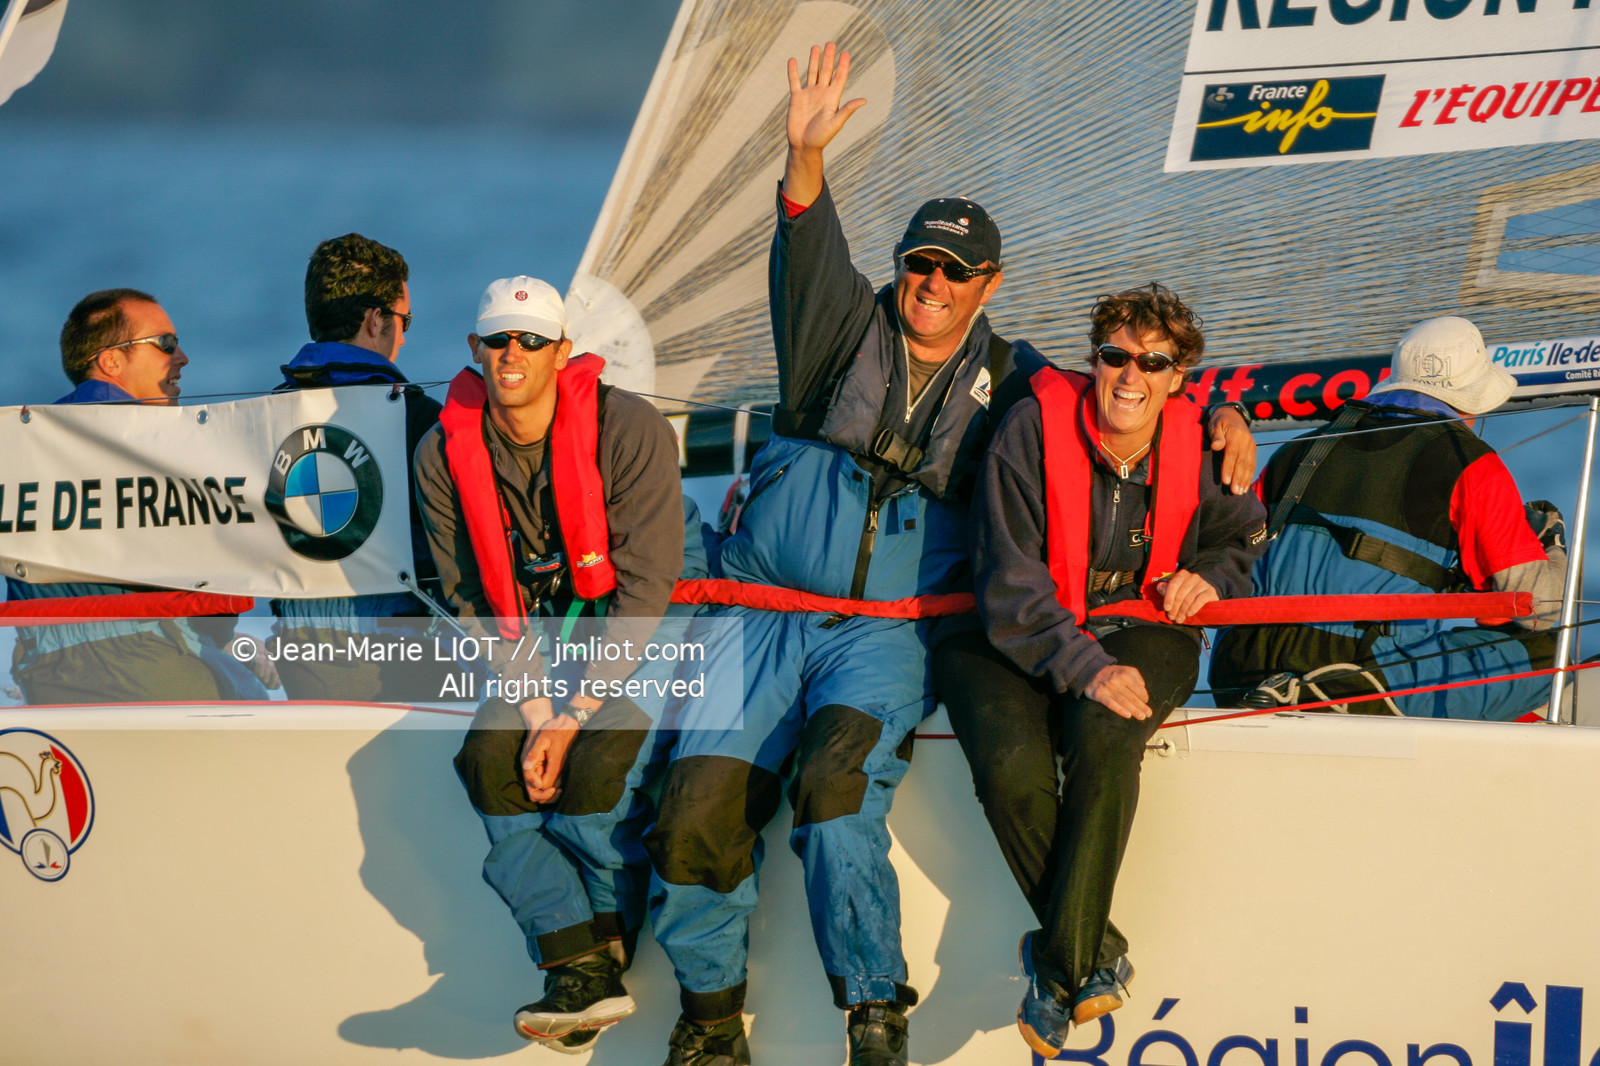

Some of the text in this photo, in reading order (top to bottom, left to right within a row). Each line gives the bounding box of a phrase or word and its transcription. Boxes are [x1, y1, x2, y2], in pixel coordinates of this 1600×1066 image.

[1248, 83, 1307, 100] France
[1238, 79, 1338, 154] info
[1492, 342, 1547, 368] Paris
[1565, 369, 1592, 380] Comité
[52, 478, 103, 532] DE
[115, 476, 255, 529] FRANCE
